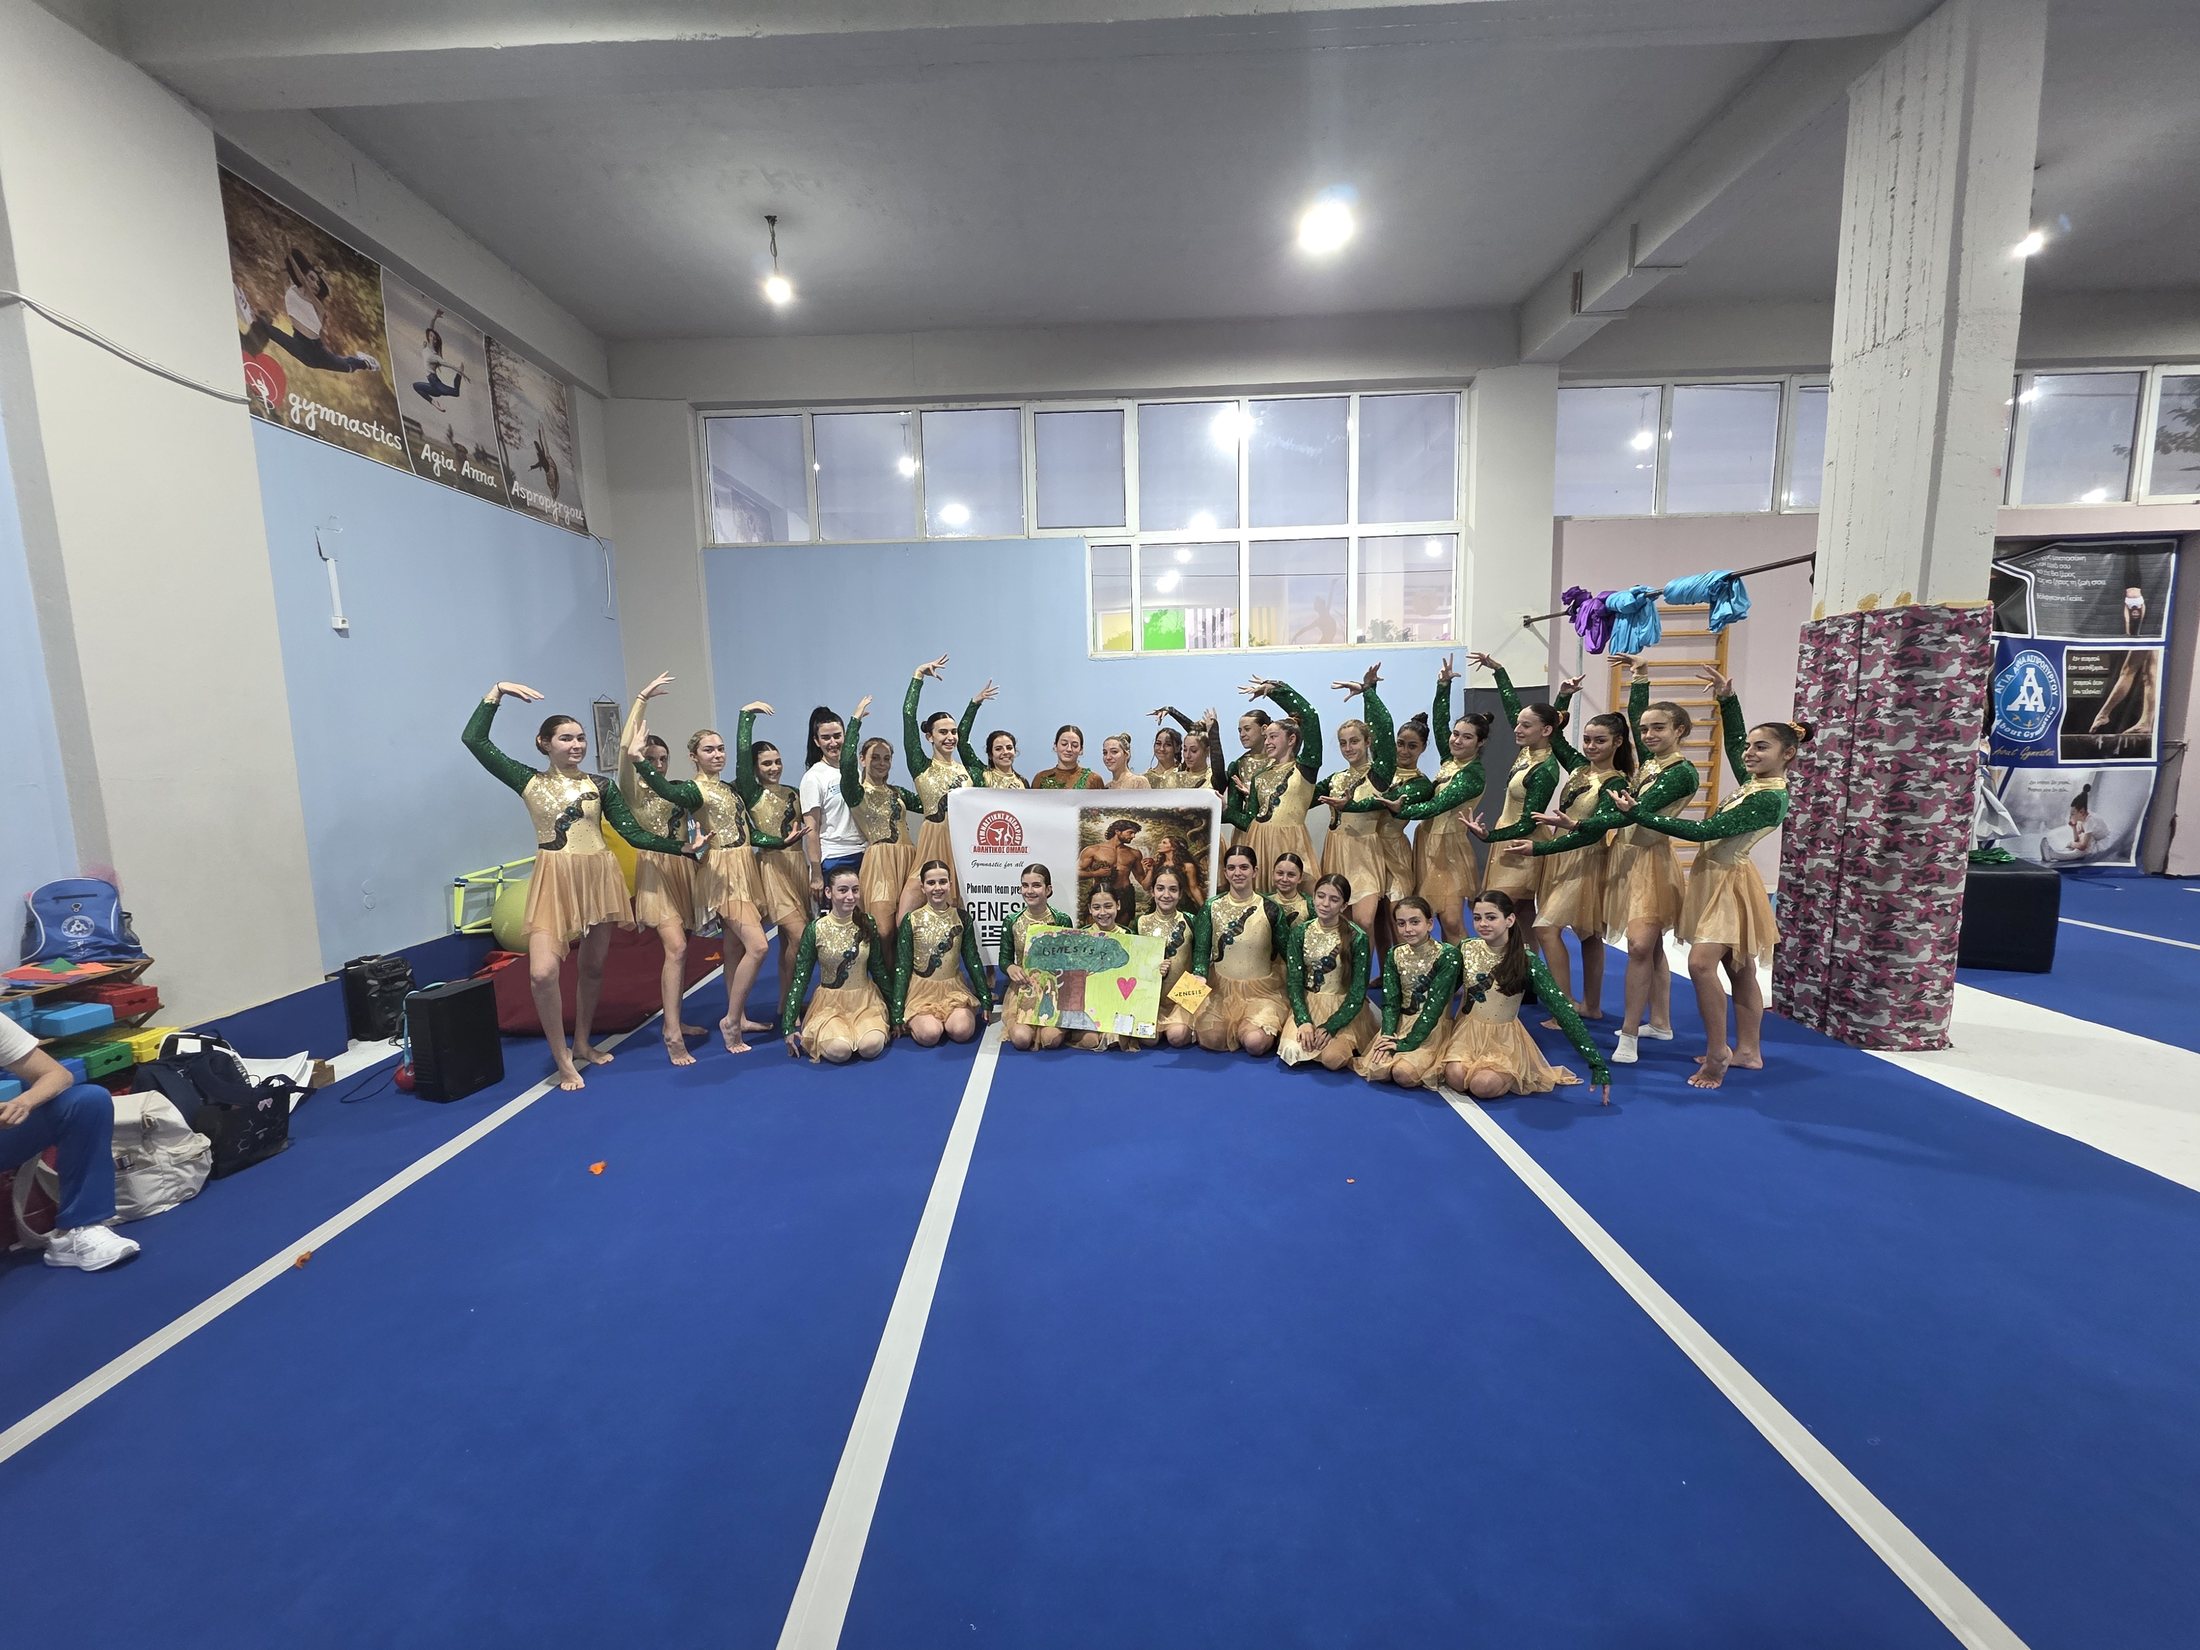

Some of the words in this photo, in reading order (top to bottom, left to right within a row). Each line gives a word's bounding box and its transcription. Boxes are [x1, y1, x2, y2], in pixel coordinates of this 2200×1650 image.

[288, 393, 402, 450] gymnastics
[421, 444, 457, 477] Agia
[461, 461, 497, 488] Anna
[511, 481, 584, 525] Aspropyrgou
[1995, 674, 2014, 694] ΑΓΙΑ
[971, 859, 1002, 868] Gymnastic
[1003, 861, 1013, 869] for
[966, 882, 993, 894] Phantom
[994, 884, 1010, 894] team
[1042, 946, 1095, 957] GENESIS
